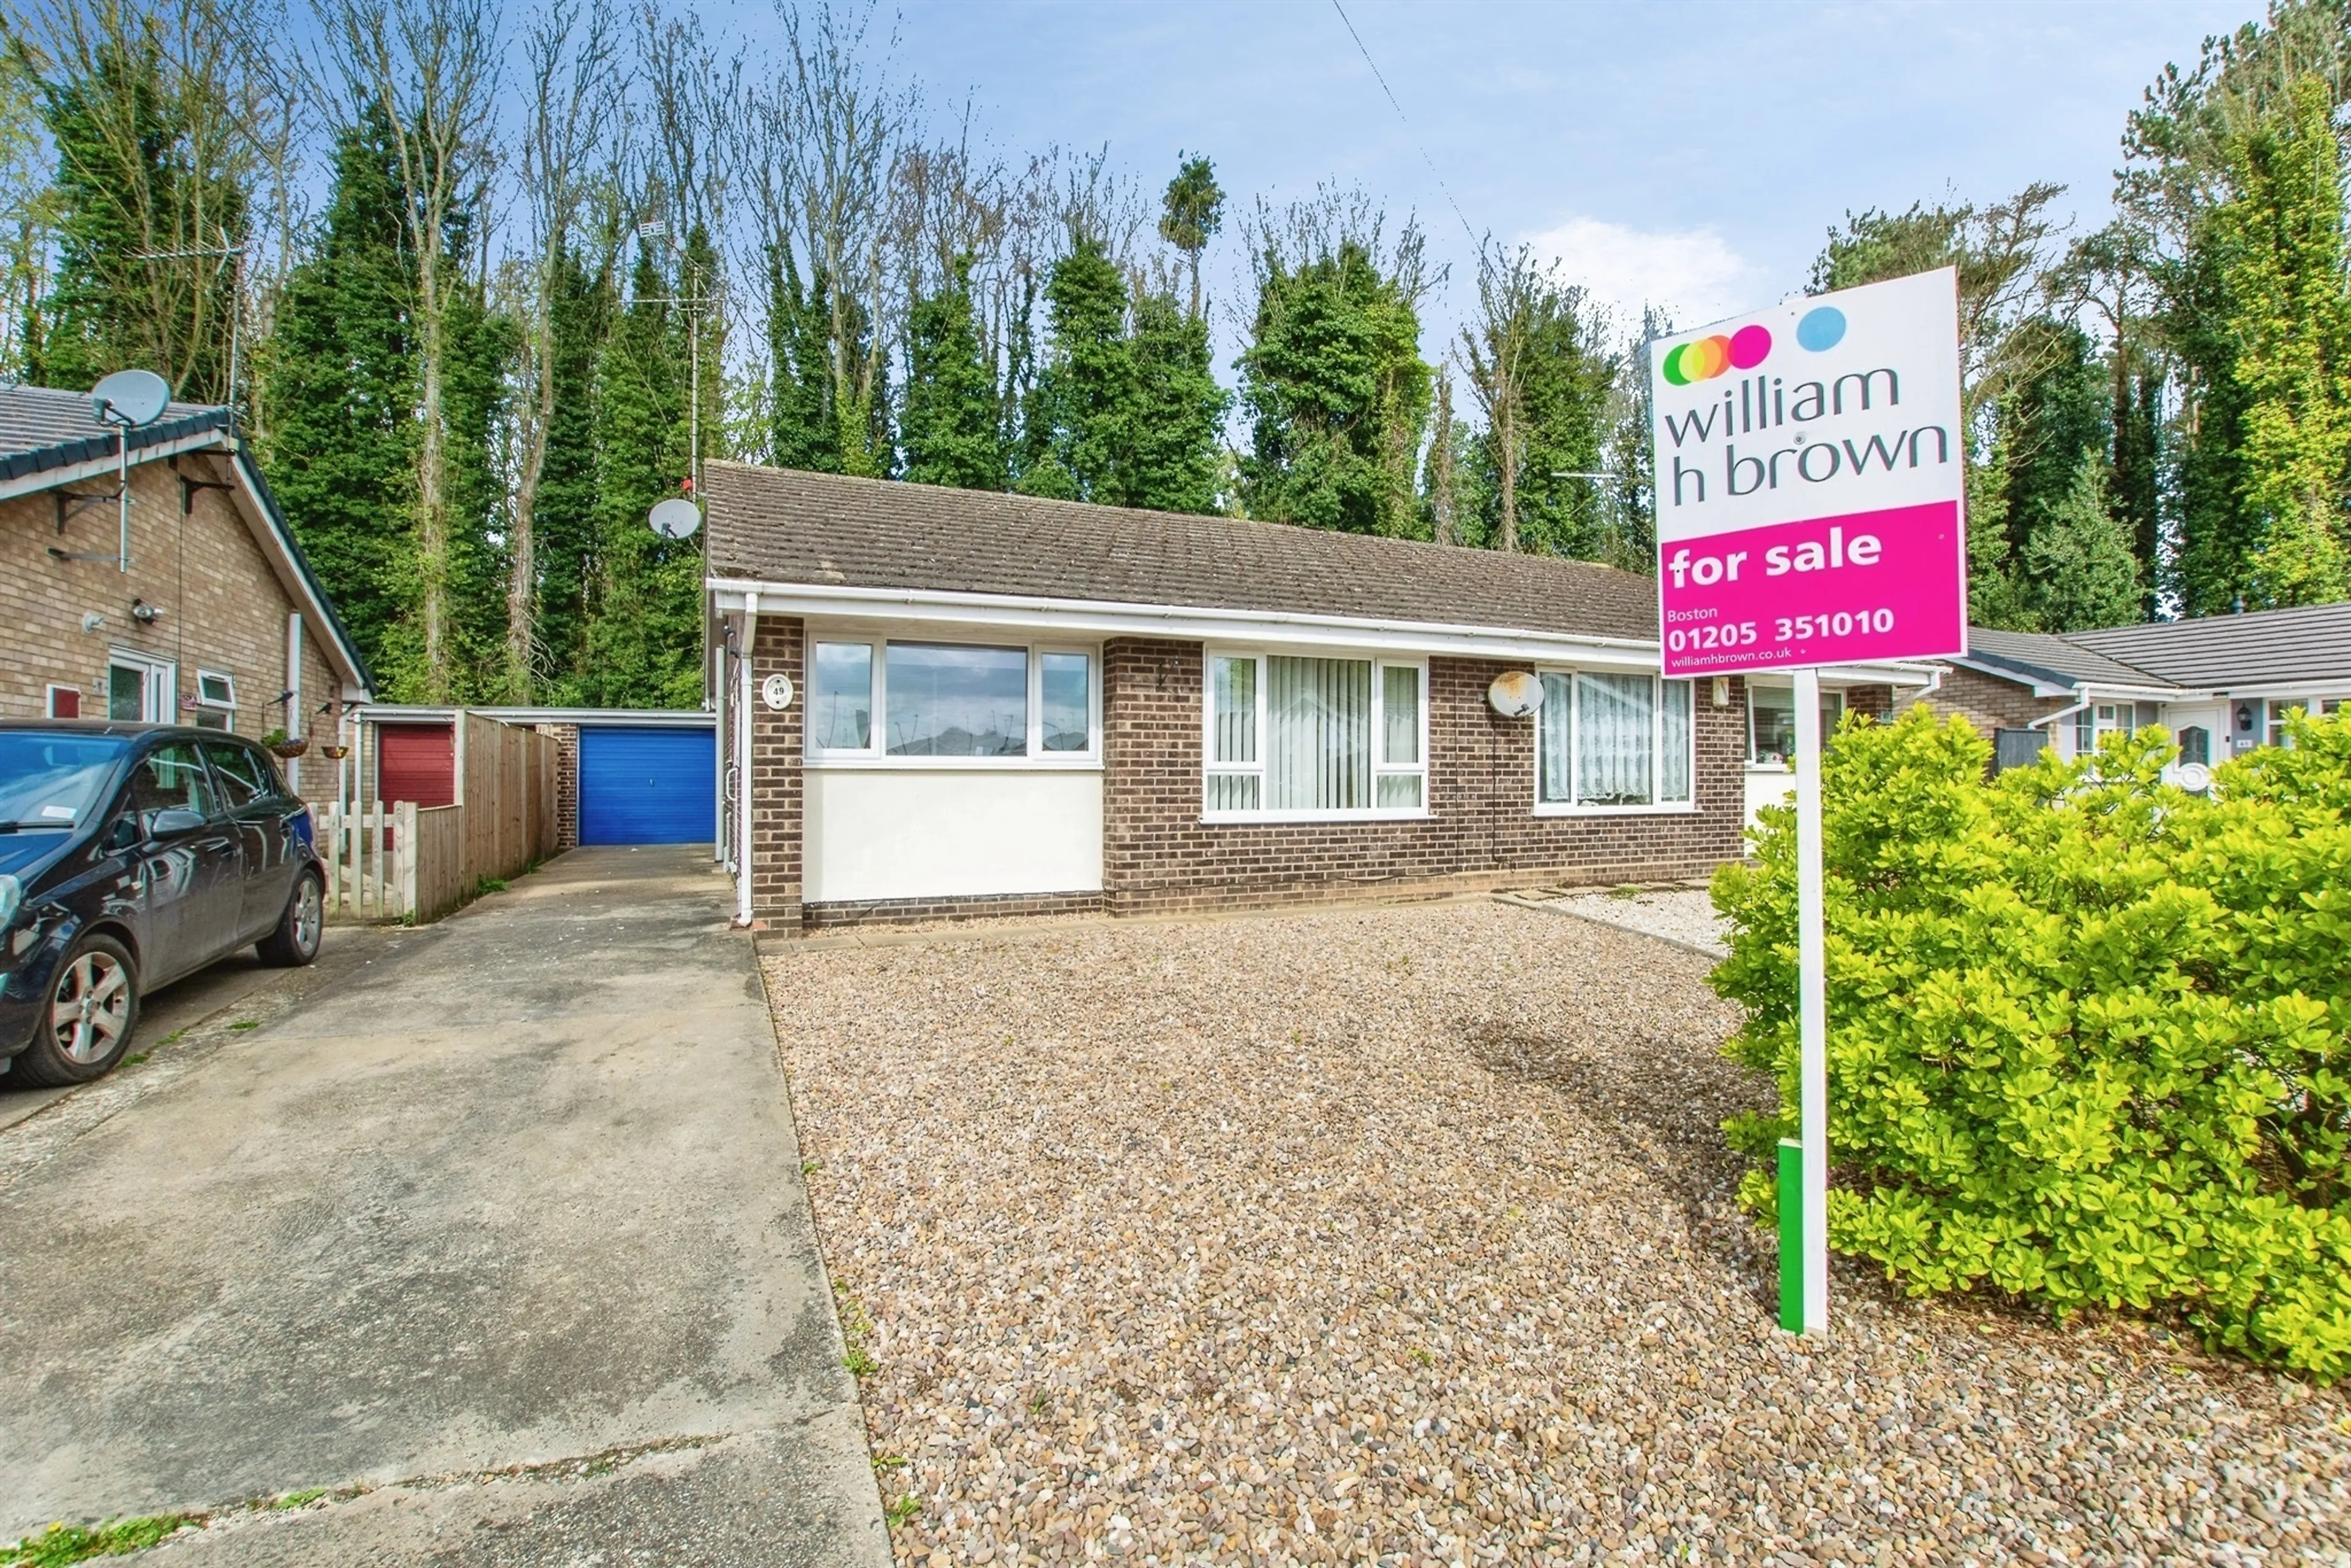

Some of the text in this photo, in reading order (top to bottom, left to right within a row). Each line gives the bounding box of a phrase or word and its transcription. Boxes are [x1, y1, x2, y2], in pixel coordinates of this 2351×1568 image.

[1665, 368, 1899, 448] william
[1674, 426, 1948, 507] h brown
[1668, 525, 1883, 588] for sale
[1667, 607, 1718, 623] Boston
[1668, 608, 1895, 652] 01205 351010
[1671, 647, 1792, 668] williamhbrown.co.uk
[773, 687, 784, 696] 49
